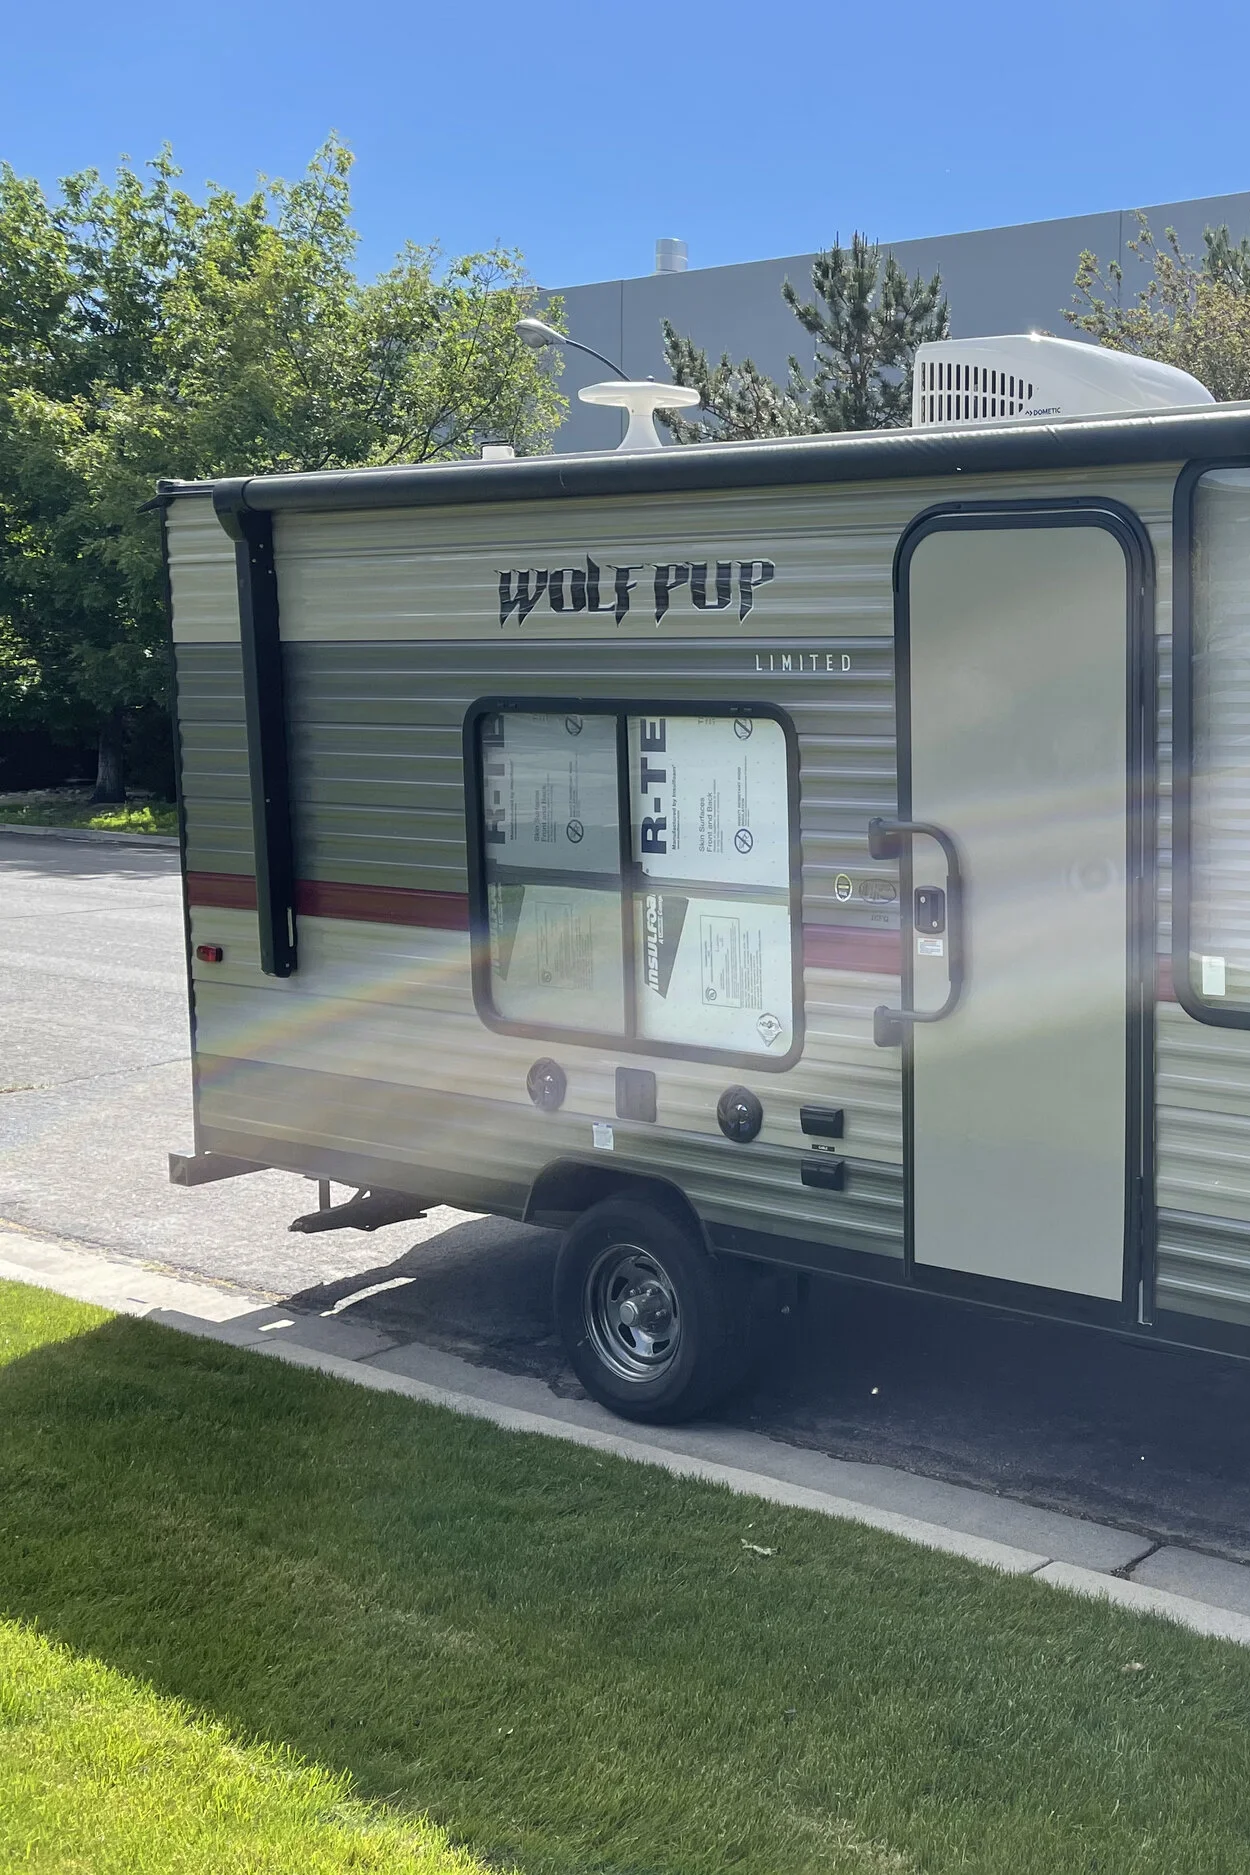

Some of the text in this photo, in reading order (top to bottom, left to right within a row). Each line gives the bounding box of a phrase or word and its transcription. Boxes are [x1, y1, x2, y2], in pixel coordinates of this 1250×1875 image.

[1033, 406, 1061, 416] DOMETIC
[493, 552, 776, 630] WOLF PUP
[755, 653, 852, 672] LIMITED
